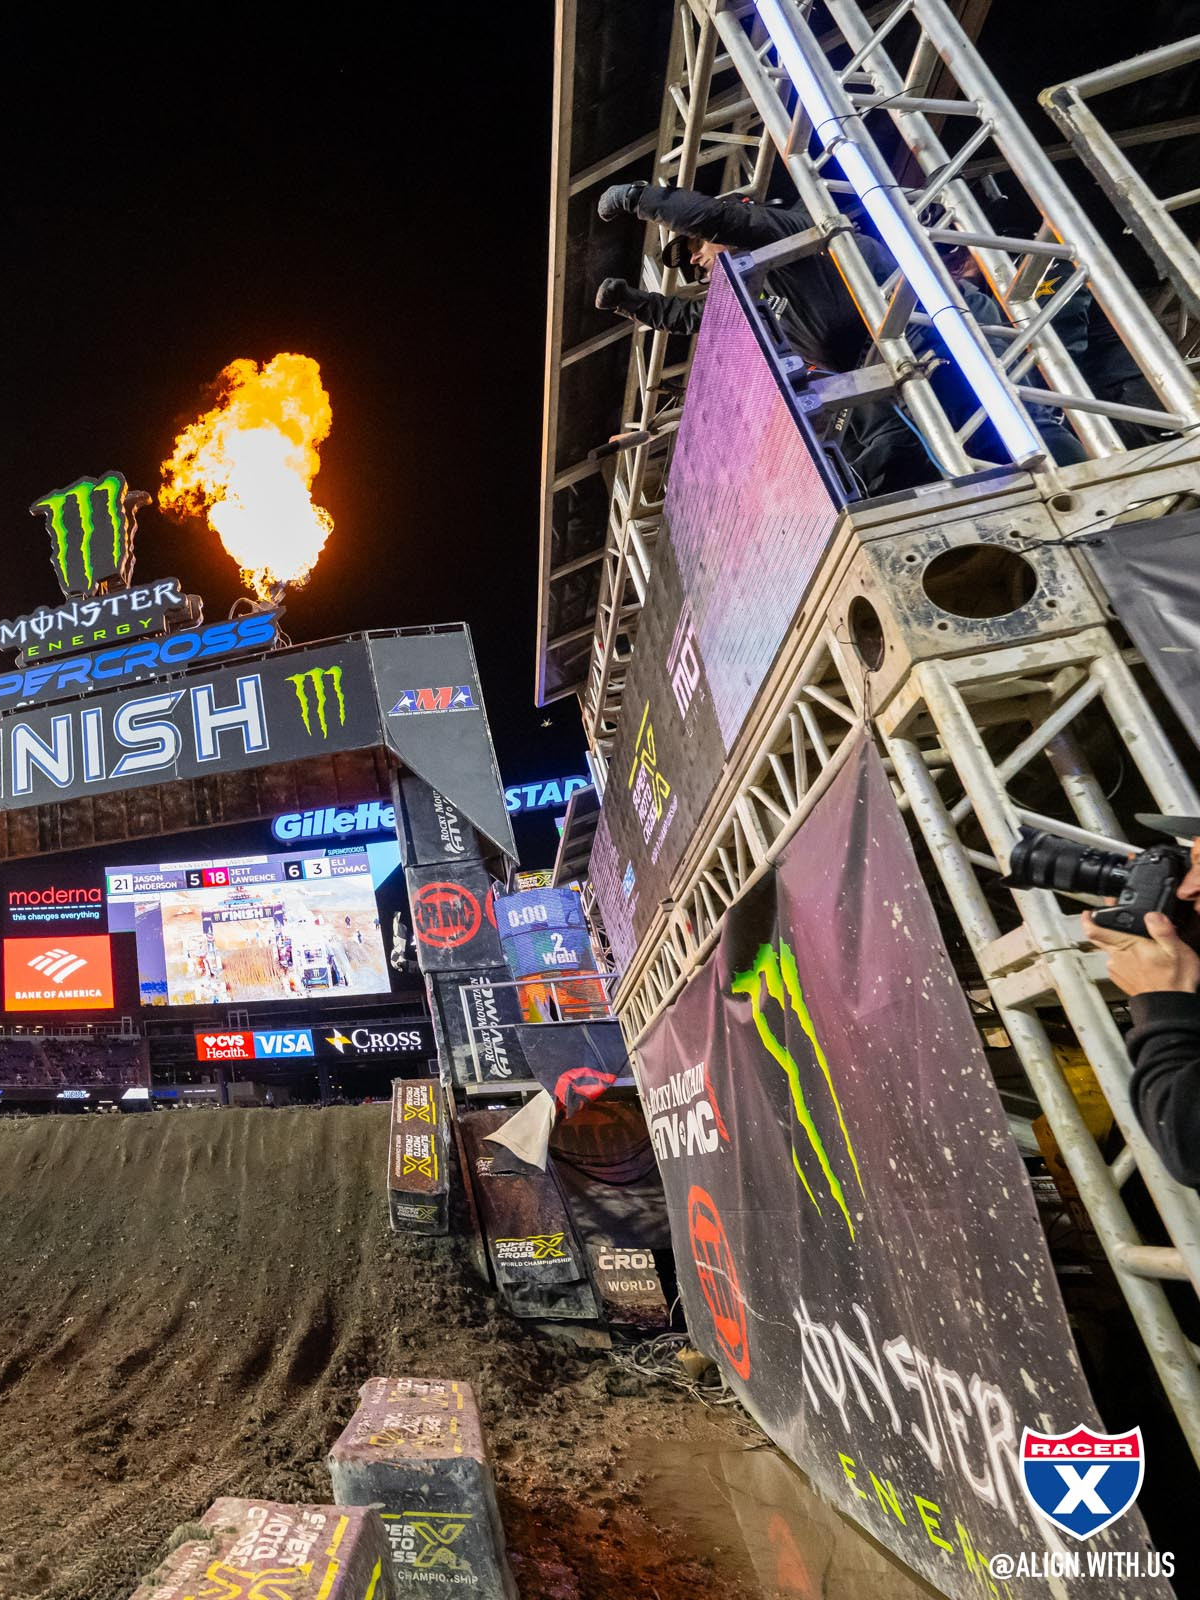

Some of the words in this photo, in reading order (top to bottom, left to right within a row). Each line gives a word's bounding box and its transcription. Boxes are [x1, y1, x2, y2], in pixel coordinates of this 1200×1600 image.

[0, 580, 181, 645] MONSTER
[28, 618, 152, 657] ENERGY
[387, 685, 479, 713] AMA
[274, 803, 396, 840] Gillette
[441, 816, 450, 841] ROCKY
[312, 863, 323, 875] 3
[331, 858, 346, 867] ELI
[331, 864, 367, 874] TOMAC
[230, 868, 251, 876] JETT
[288, 864, 300, 877] 6
[114, 877, 129, 891] 21
[134, 875, 163, 883] JASON
[190, 873, 200, 886] 5
[208, 871, 226, 885] 18
[231, 874, 276, 884] LAWRENCE
[134, 881, 178, 891] ANDERSON
[9, 886, 102, 904] moderna
[12, 913, 27, 921] this
[27, 912, 59, 922] changes
[60, 911, 100, 920] everything
[221, 907, 264, 921] FINISH
[508, 905, 548, 928] 0:00
[550, 932, 564, 952] 2
[15, 991, 41, 1000] BANK
[43, 990, 56, 999] OF
[58, 988, 103, 998] AMERICA
[216, 1035, 244, 1046] CVS
[256, 1034, 312, 1054] VISA
[351, 1029, 422, 1049] CROSS
[357, 1045, 422, 1053] INSURANCE
[481, 1030, 495, 1062] ROCKY
[413, 1087, 421, 1106] MOTO
[419, 1085, 428, 1107] SUPER
[405, 1135, 413, 1157] CROSS
[413, 1135, 421, 1157] MOTO
[420, 1134, 429, 1158] SUPER
[496, 1241, 534, 1249] SUPER
[497, 1251, 535, 1259] CROSS
[523, 1257, 572, 1267] CHAMPIONSHIP
[608, 1280, 656, 1292] WORLD
[384, 1524, 416, 1537] PER
[388, 1537, 415, 1550] TO
